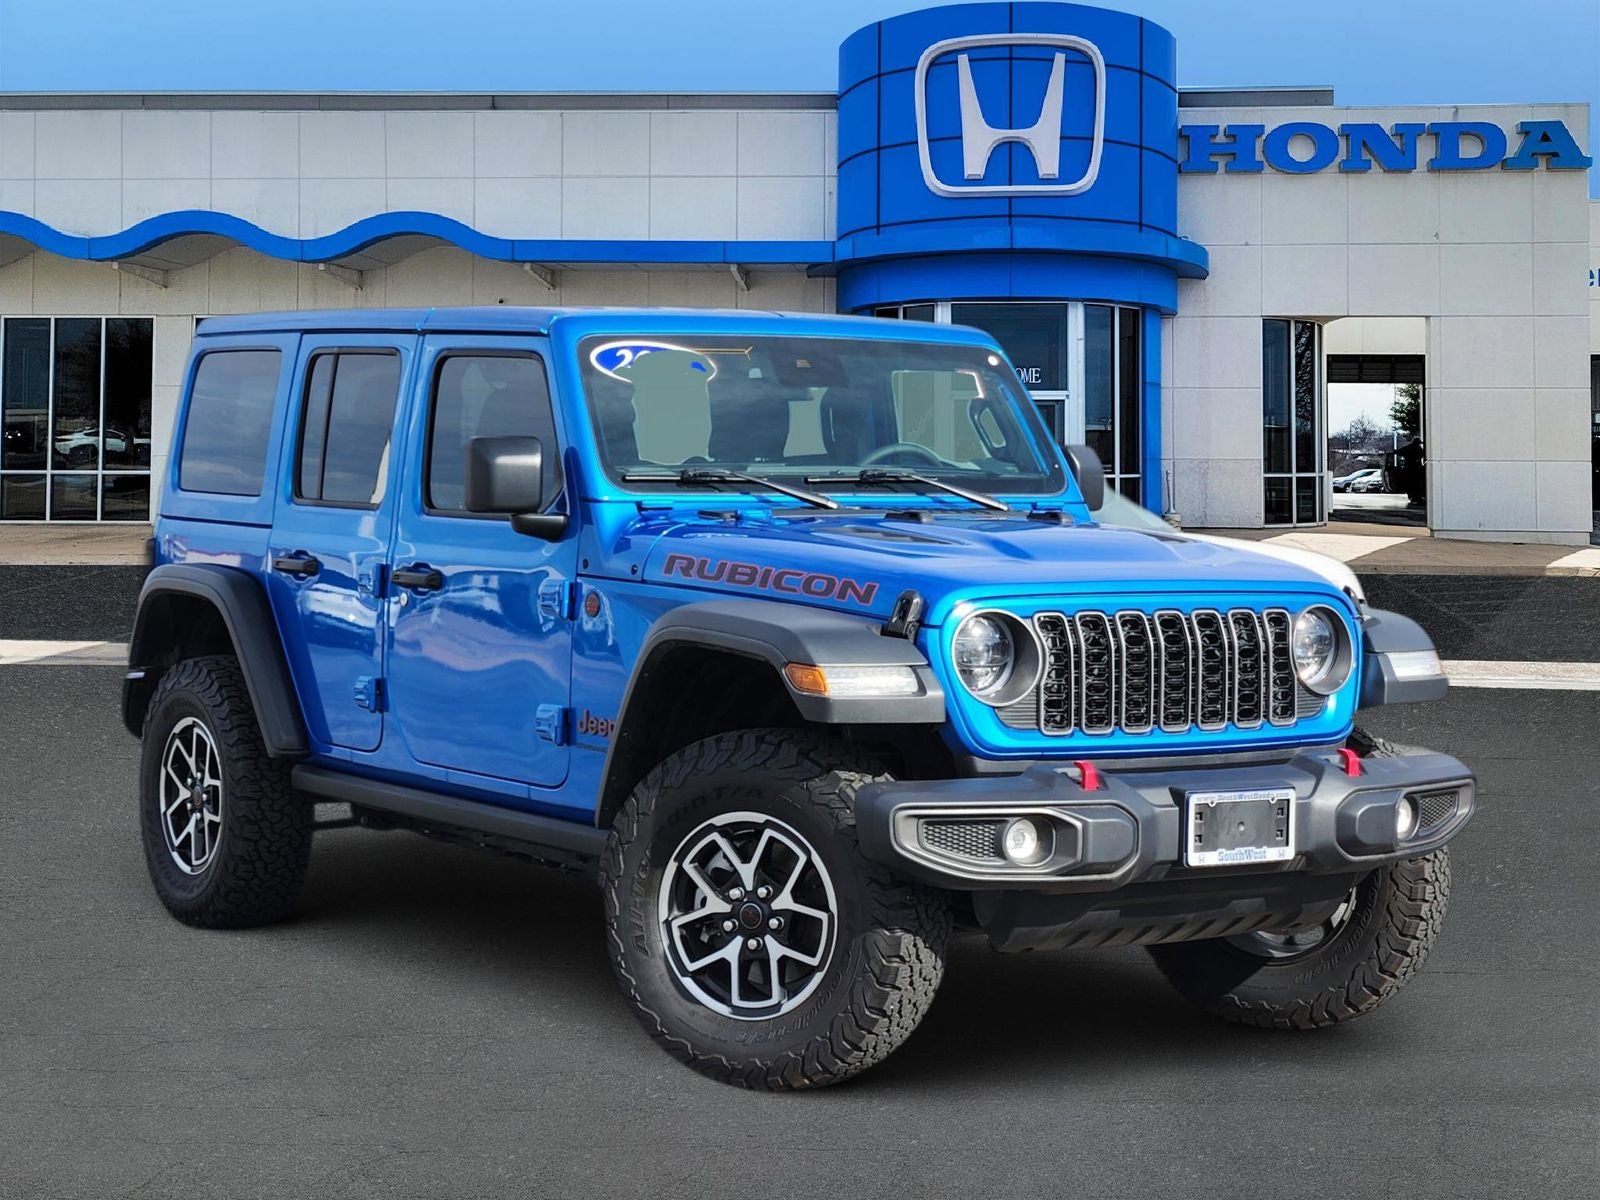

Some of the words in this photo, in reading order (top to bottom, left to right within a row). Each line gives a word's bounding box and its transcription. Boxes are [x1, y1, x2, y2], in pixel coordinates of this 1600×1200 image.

[1178, 120, 1592, 174] HONDA
[663, 553, 880, 606] RUBICON
[1218, 848, 1267, 862] SouthWest
